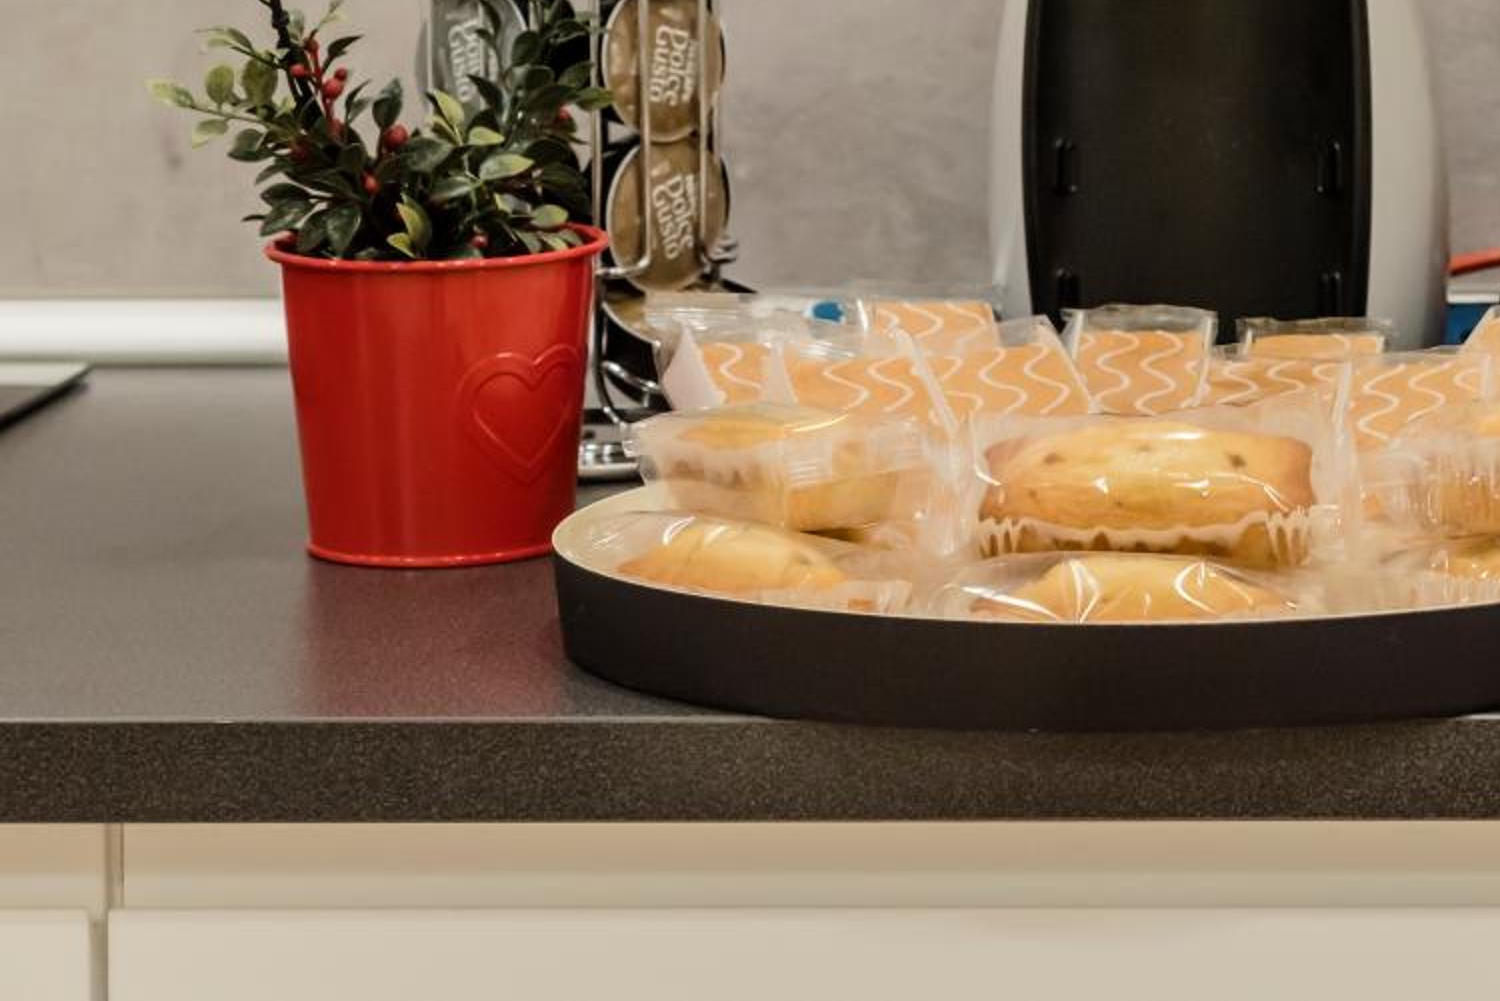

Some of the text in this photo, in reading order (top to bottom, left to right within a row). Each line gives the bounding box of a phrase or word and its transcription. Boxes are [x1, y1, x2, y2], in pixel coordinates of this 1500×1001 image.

[649, 24, 670, 102] Gusto
[664, 30, 689, 106] Dolce
[652, 185, 680, 259] Gusto
[667, 175, 694, 249] Dolce
